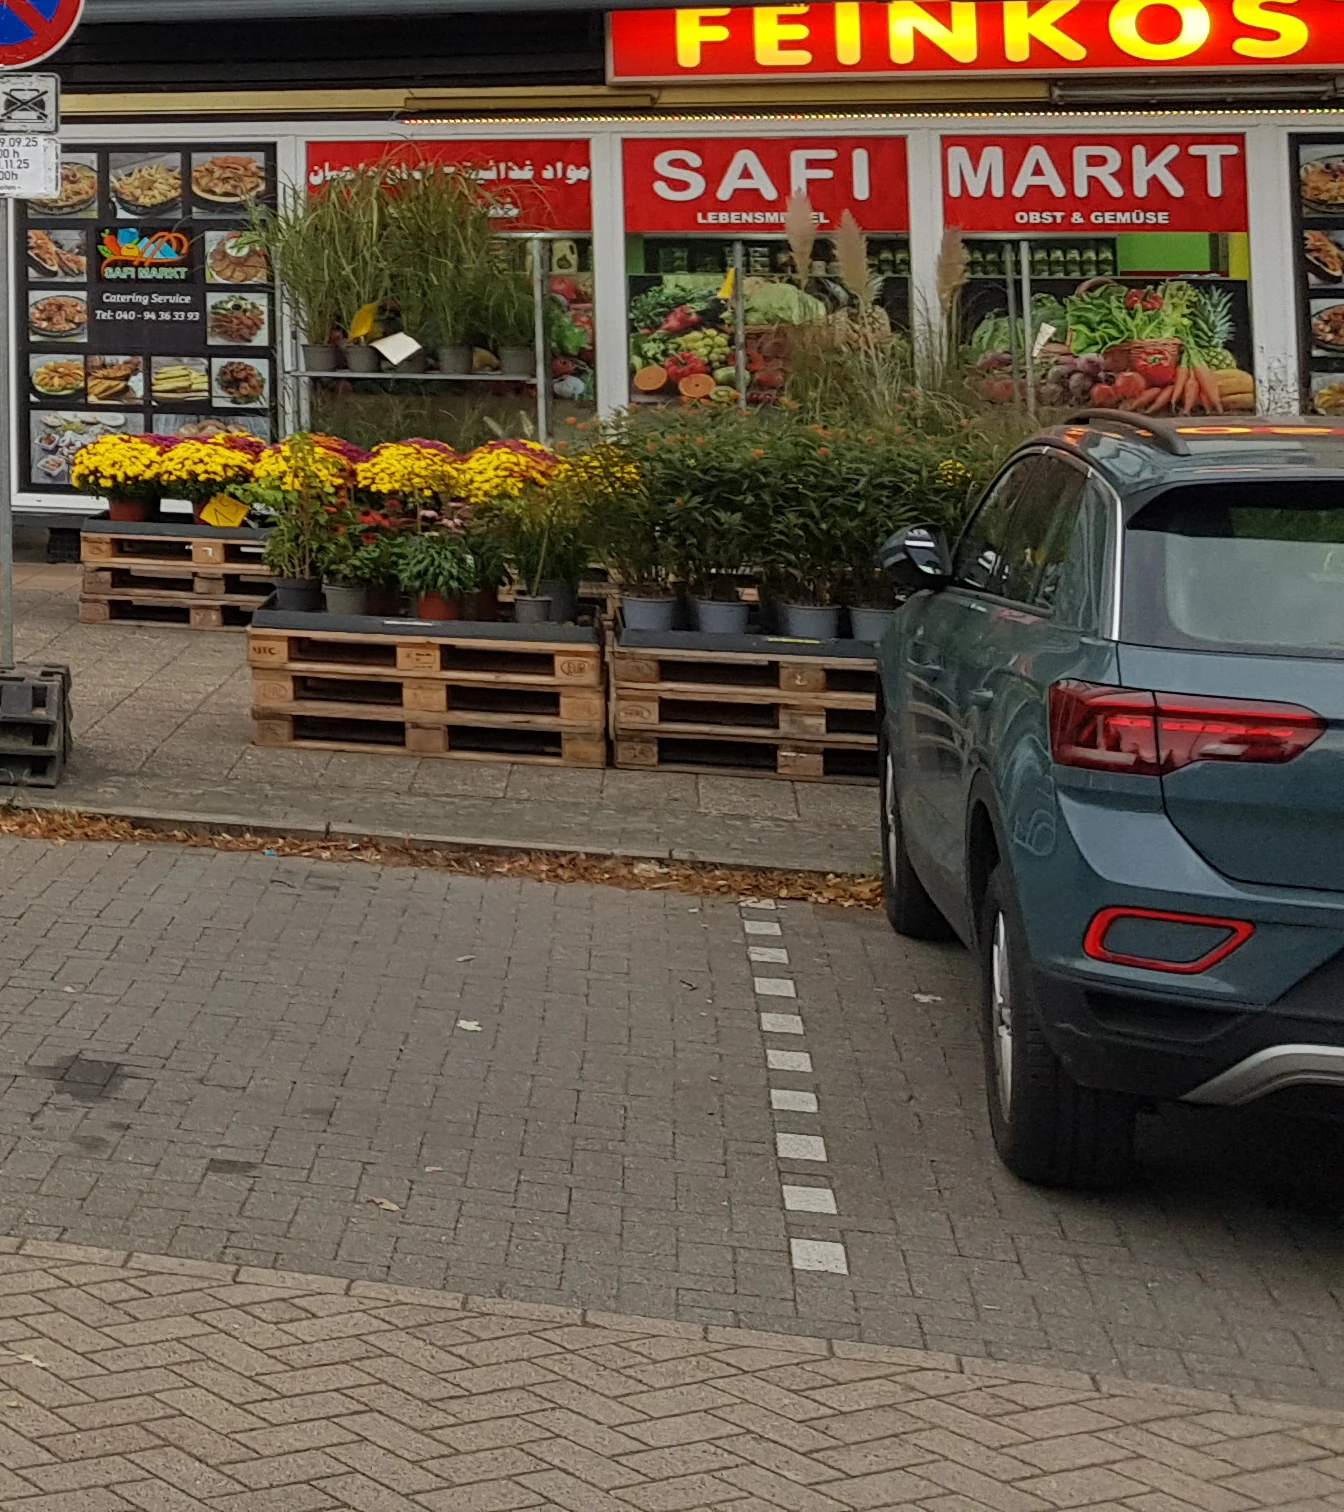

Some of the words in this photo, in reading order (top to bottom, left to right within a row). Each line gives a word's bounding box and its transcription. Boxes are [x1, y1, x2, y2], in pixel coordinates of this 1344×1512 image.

[12, 149, 20, 159] h
[541, 161, 590, 185] مواد
[652, 147, 870, 201] SAFI
[947, 143, 1240, 200] MARKT
[697, 211, 830, 224] LEBENSMIEL
[1014, 211, 1066, 226] OBST
[1070, 211, 1084, 225] &
[1089, 208, 1170, 225] GEMÜSE
[104, 267, 135, 279] SAFI
[137, 267, 189, 279] MARKT
[102, 293, 149, 306] Catering
[151, 293, 192, 304] Service
[115, 311, 136, 321] 040
[143, 311, 156, 321] 94
[158, 312, 171, 321] 36
[172, 312, 186, 321] 33
[187, 312, 200, 321] 93
